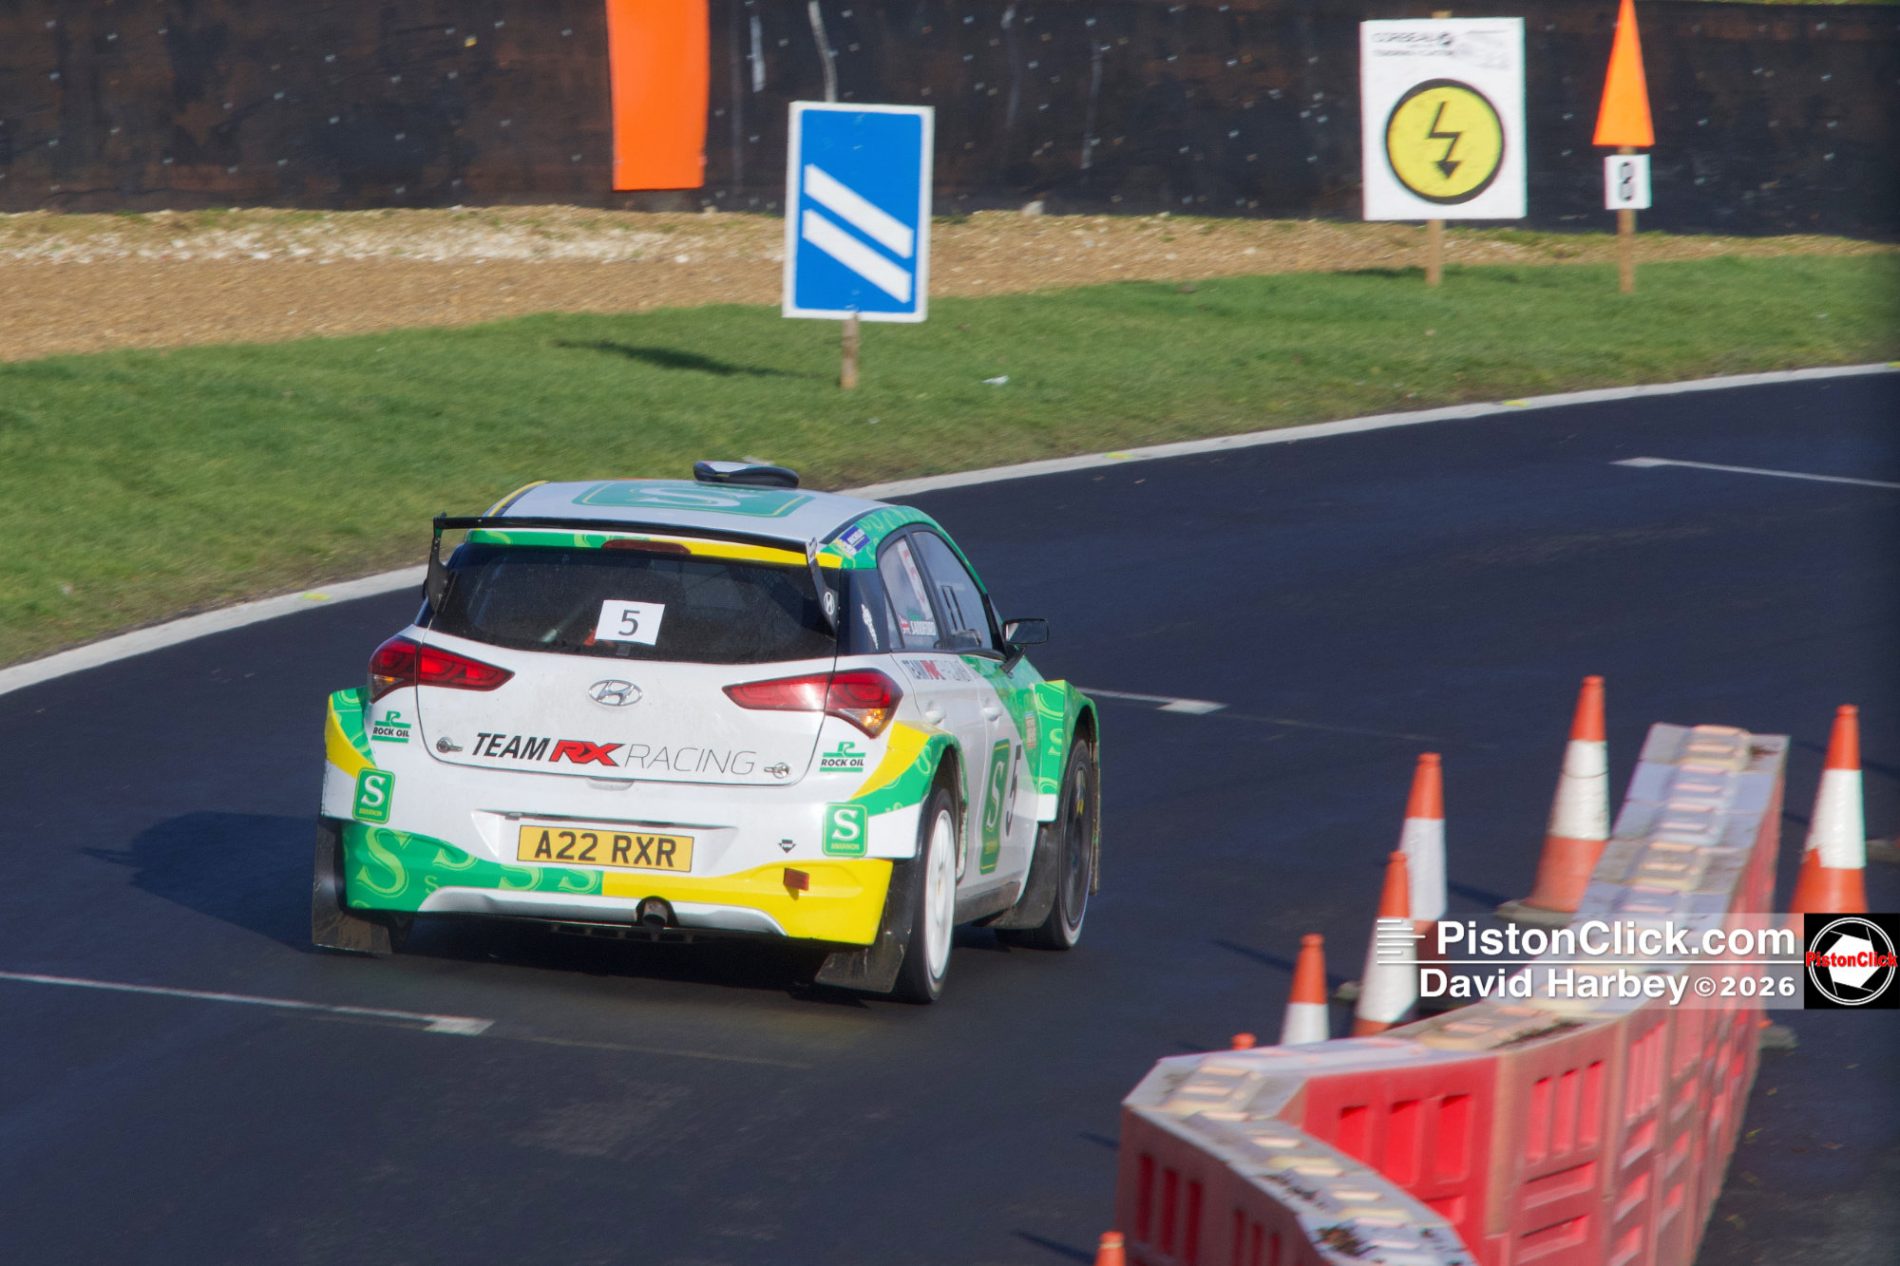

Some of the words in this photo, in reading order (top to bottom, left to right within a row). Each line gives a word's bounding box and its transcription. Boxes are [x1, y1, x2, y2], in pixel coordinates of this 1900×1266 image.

[618, 608, 640, 637] 5
[373, 726, 394, 737] ROCK
[396, 728, 410, 738] OIL
[471, 732, 551, 762] TEAM
[549, 740, 627, 768] RX
[625, 742, 758, 776] RACING
[821, 758, 848, 767] ROCK
[849, 758, 865, 767] OIL
[361, 775, 385, 807] S
[1006, 744, 1022, 837] 5
[832, 808, 860, 841] S
[534, 829, 599, 862] A22
[612, 834, 678, 868] RXR
